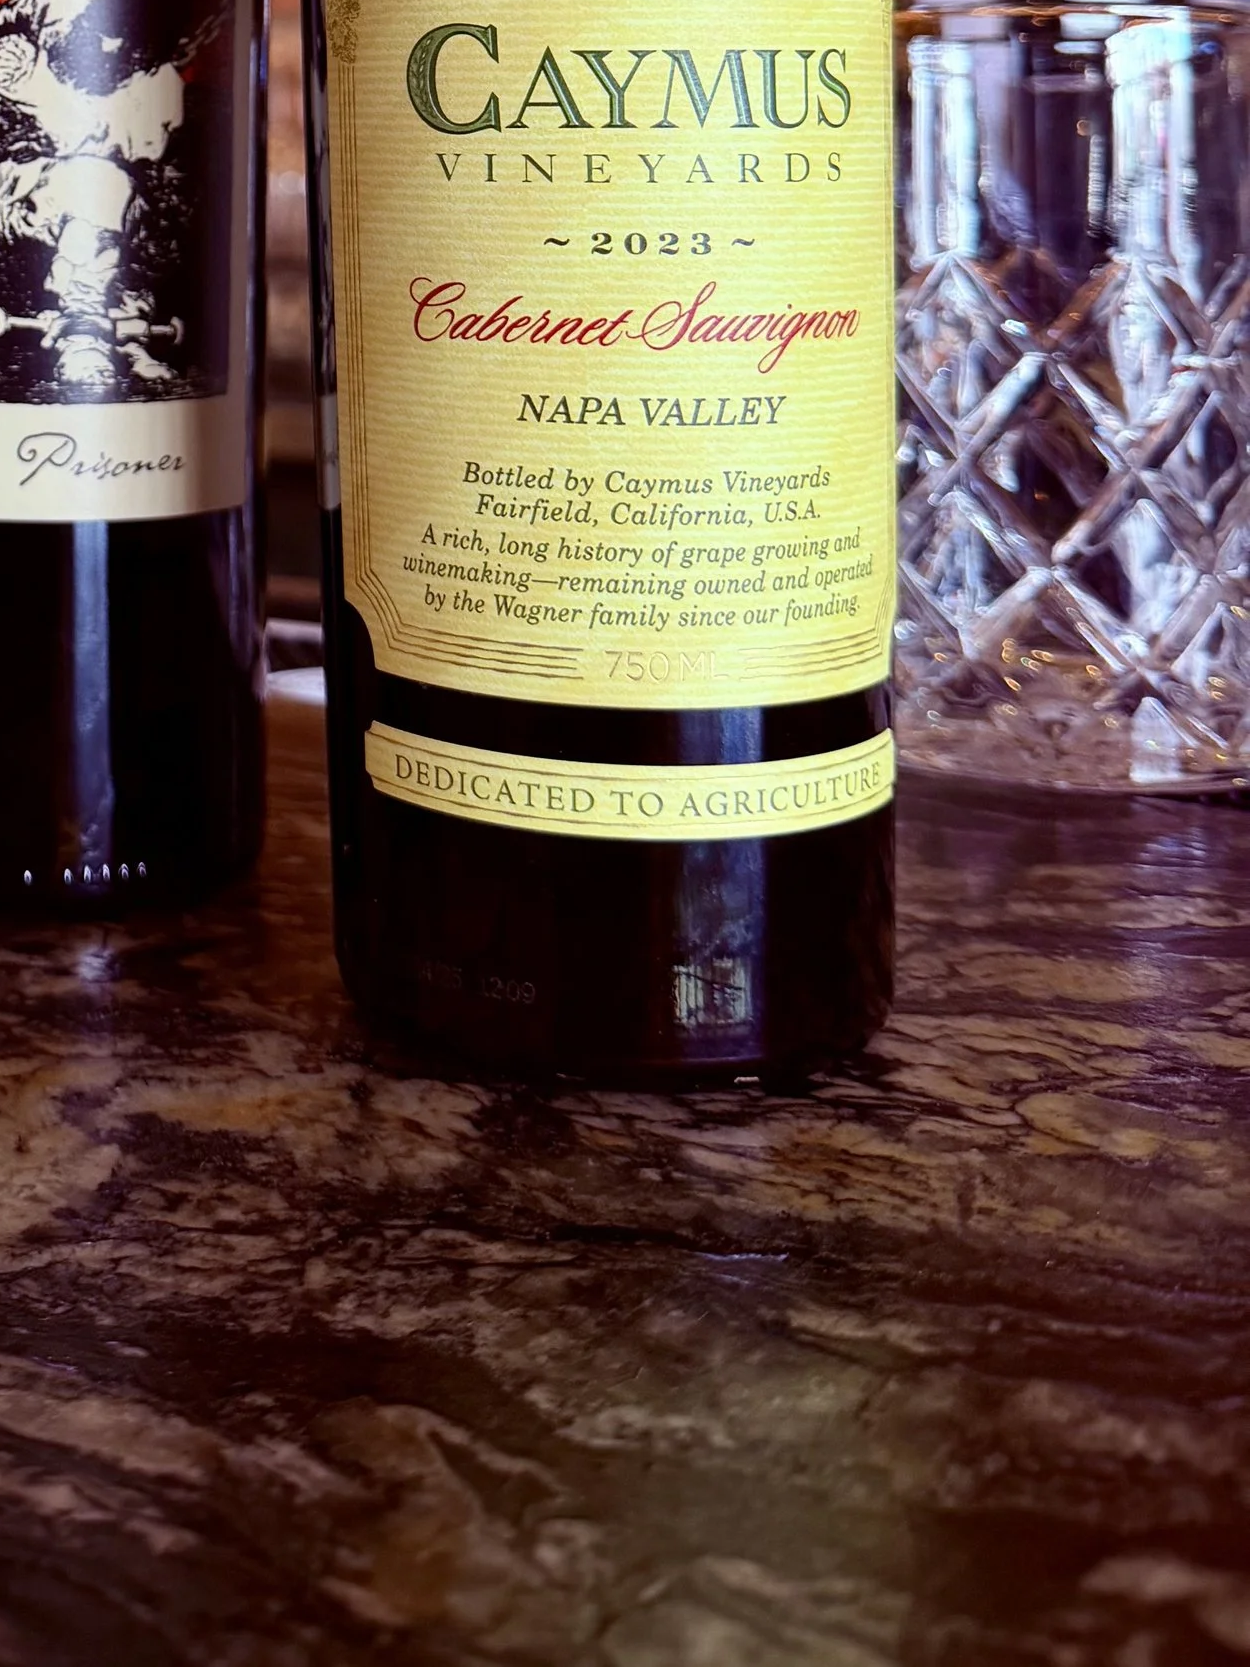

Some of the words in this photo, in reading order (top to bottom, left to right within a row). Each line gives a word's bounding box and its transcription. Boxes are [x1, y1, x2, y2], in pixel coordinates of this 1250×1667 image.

[406, 22, 852, 135] CAYMUS
[435, 151, 842, 184] VINEYARDS
[590, 231, 713, 256] 2023
[409, 276, 627, 347] Cabernet
[625, 280, 860, 374] Sauvignon
[516, 393, 626, 426] NAPA
[639, 394, 787, 427] VALLEY
[17, 431, 187, 487] Prisoner
[462, 461, 554, 490] Bottled
[564, 468, 594, 497] by
[605, 470, 713, 499] Caymus
[723, 464, 831, 496] Vineyards
[475, 493, 599, 527] Fairfield,
[611, 501, 754, 531] California,
[764, 498, 821, 523] U.S.A.
[421, 523, 437, 545] A
[442, 527, 491, 557] rich,
[499, 532, 550, 563] long
[557, 537, 643, 568] history
[651, 540, 678, 568] of
[680, 544, 746, 569] grape
[751, 535, 830, 566] growing
[834, 526, 861, 553] and
[693, 570, 766, 595] owned
[772, 566, 810, 591] and
[814, 553, 873, 591] operated
[424, 584, 446, 612] by
[453, 590, 485, 614] the
[494, 594, 582, 626] Wagner
[588, 602, 670, 632] family
[678, 605, 736, 627] since
[743, 607, 779, 625] our
[784, 593, 861, 627] founding.
[605, 650, 670, 683] 750
[679, 650, 729, 681] ML
[394, 753, 595, 814] DEDICATED
[610, 789, 664, 818] TO
[678, 761, 882, 818] AGRICULTURE
